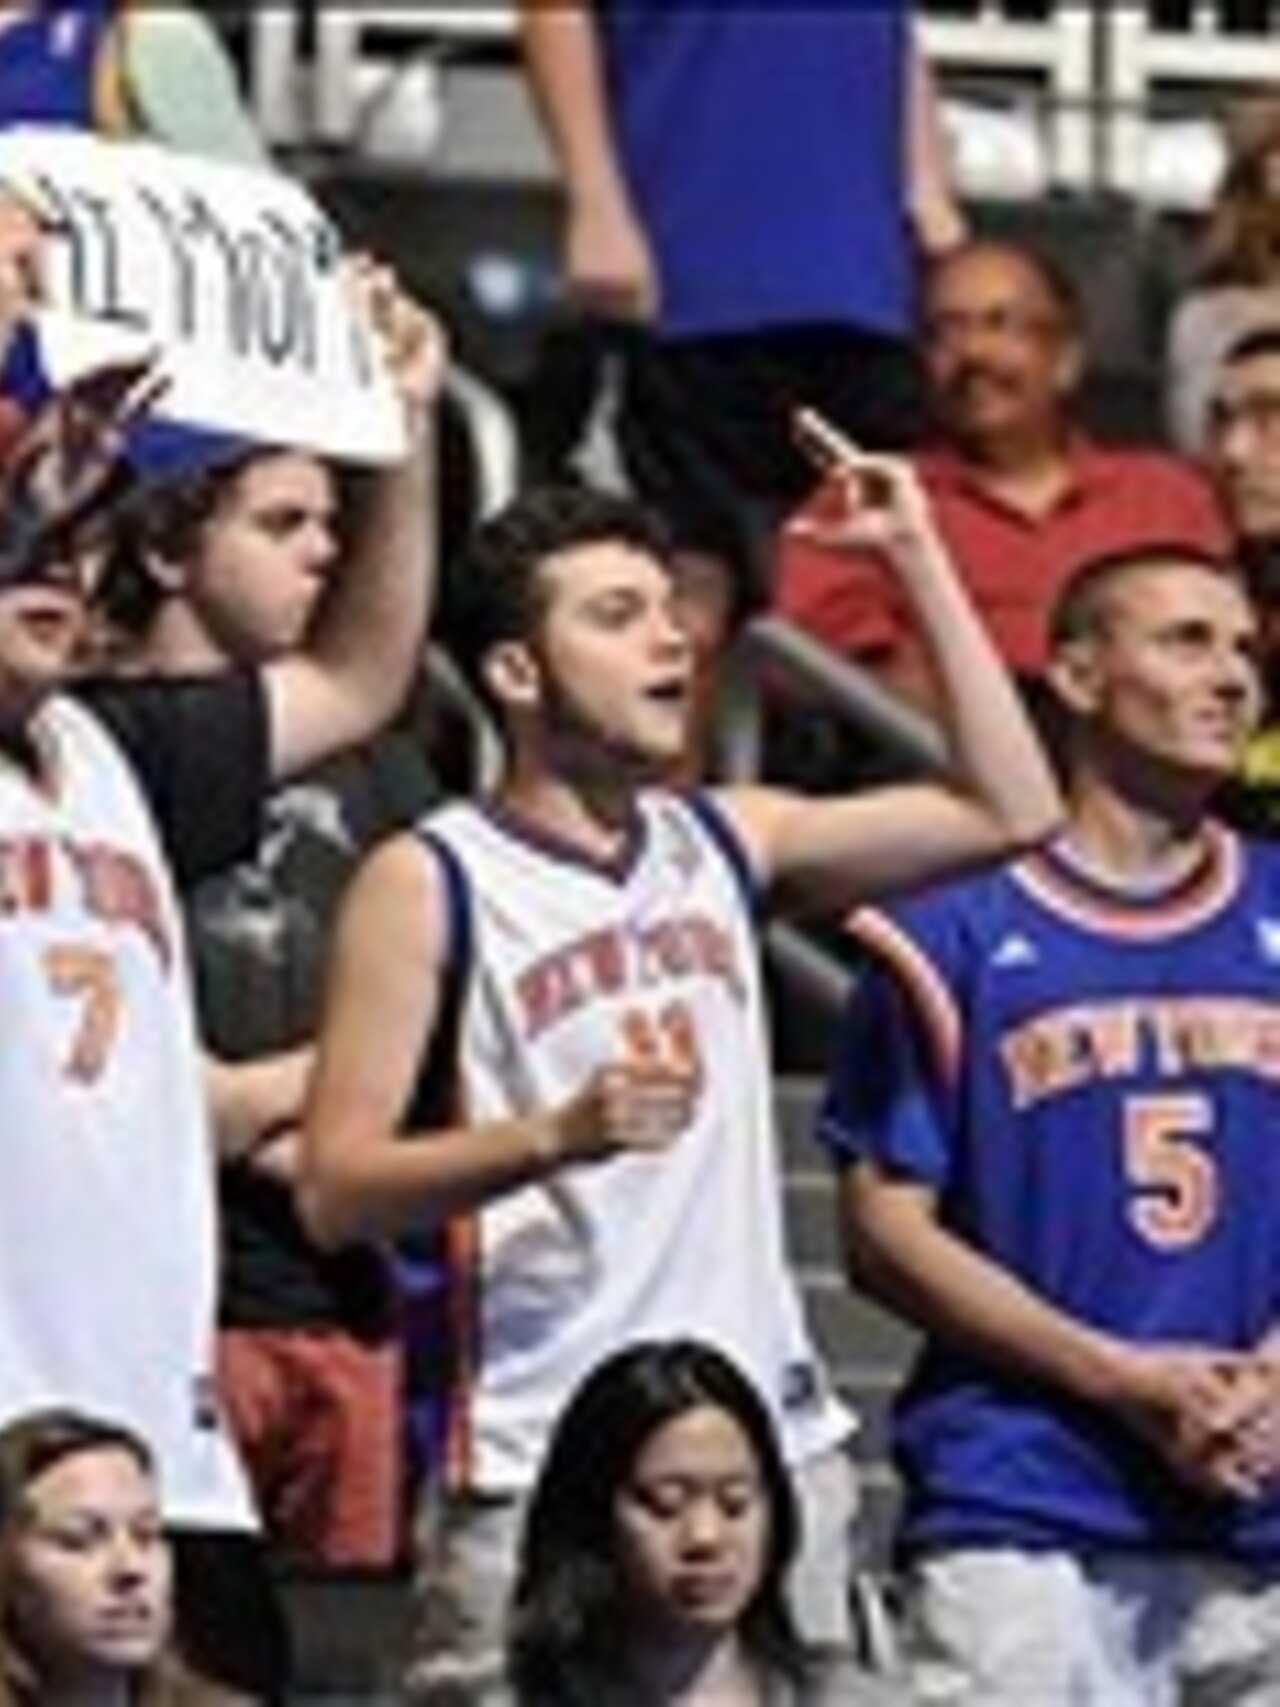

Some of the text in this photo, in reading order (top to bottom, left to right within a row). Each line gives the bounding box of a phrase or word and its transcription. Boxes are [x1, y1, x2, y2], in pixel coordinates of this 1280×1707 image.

[40, 943, 121, 1090] 7
[515, 922, 627, 1044] NEW
[998, 1000, 1138, 1112] NEW
[1121, 1093, 1217, 1252] 5
